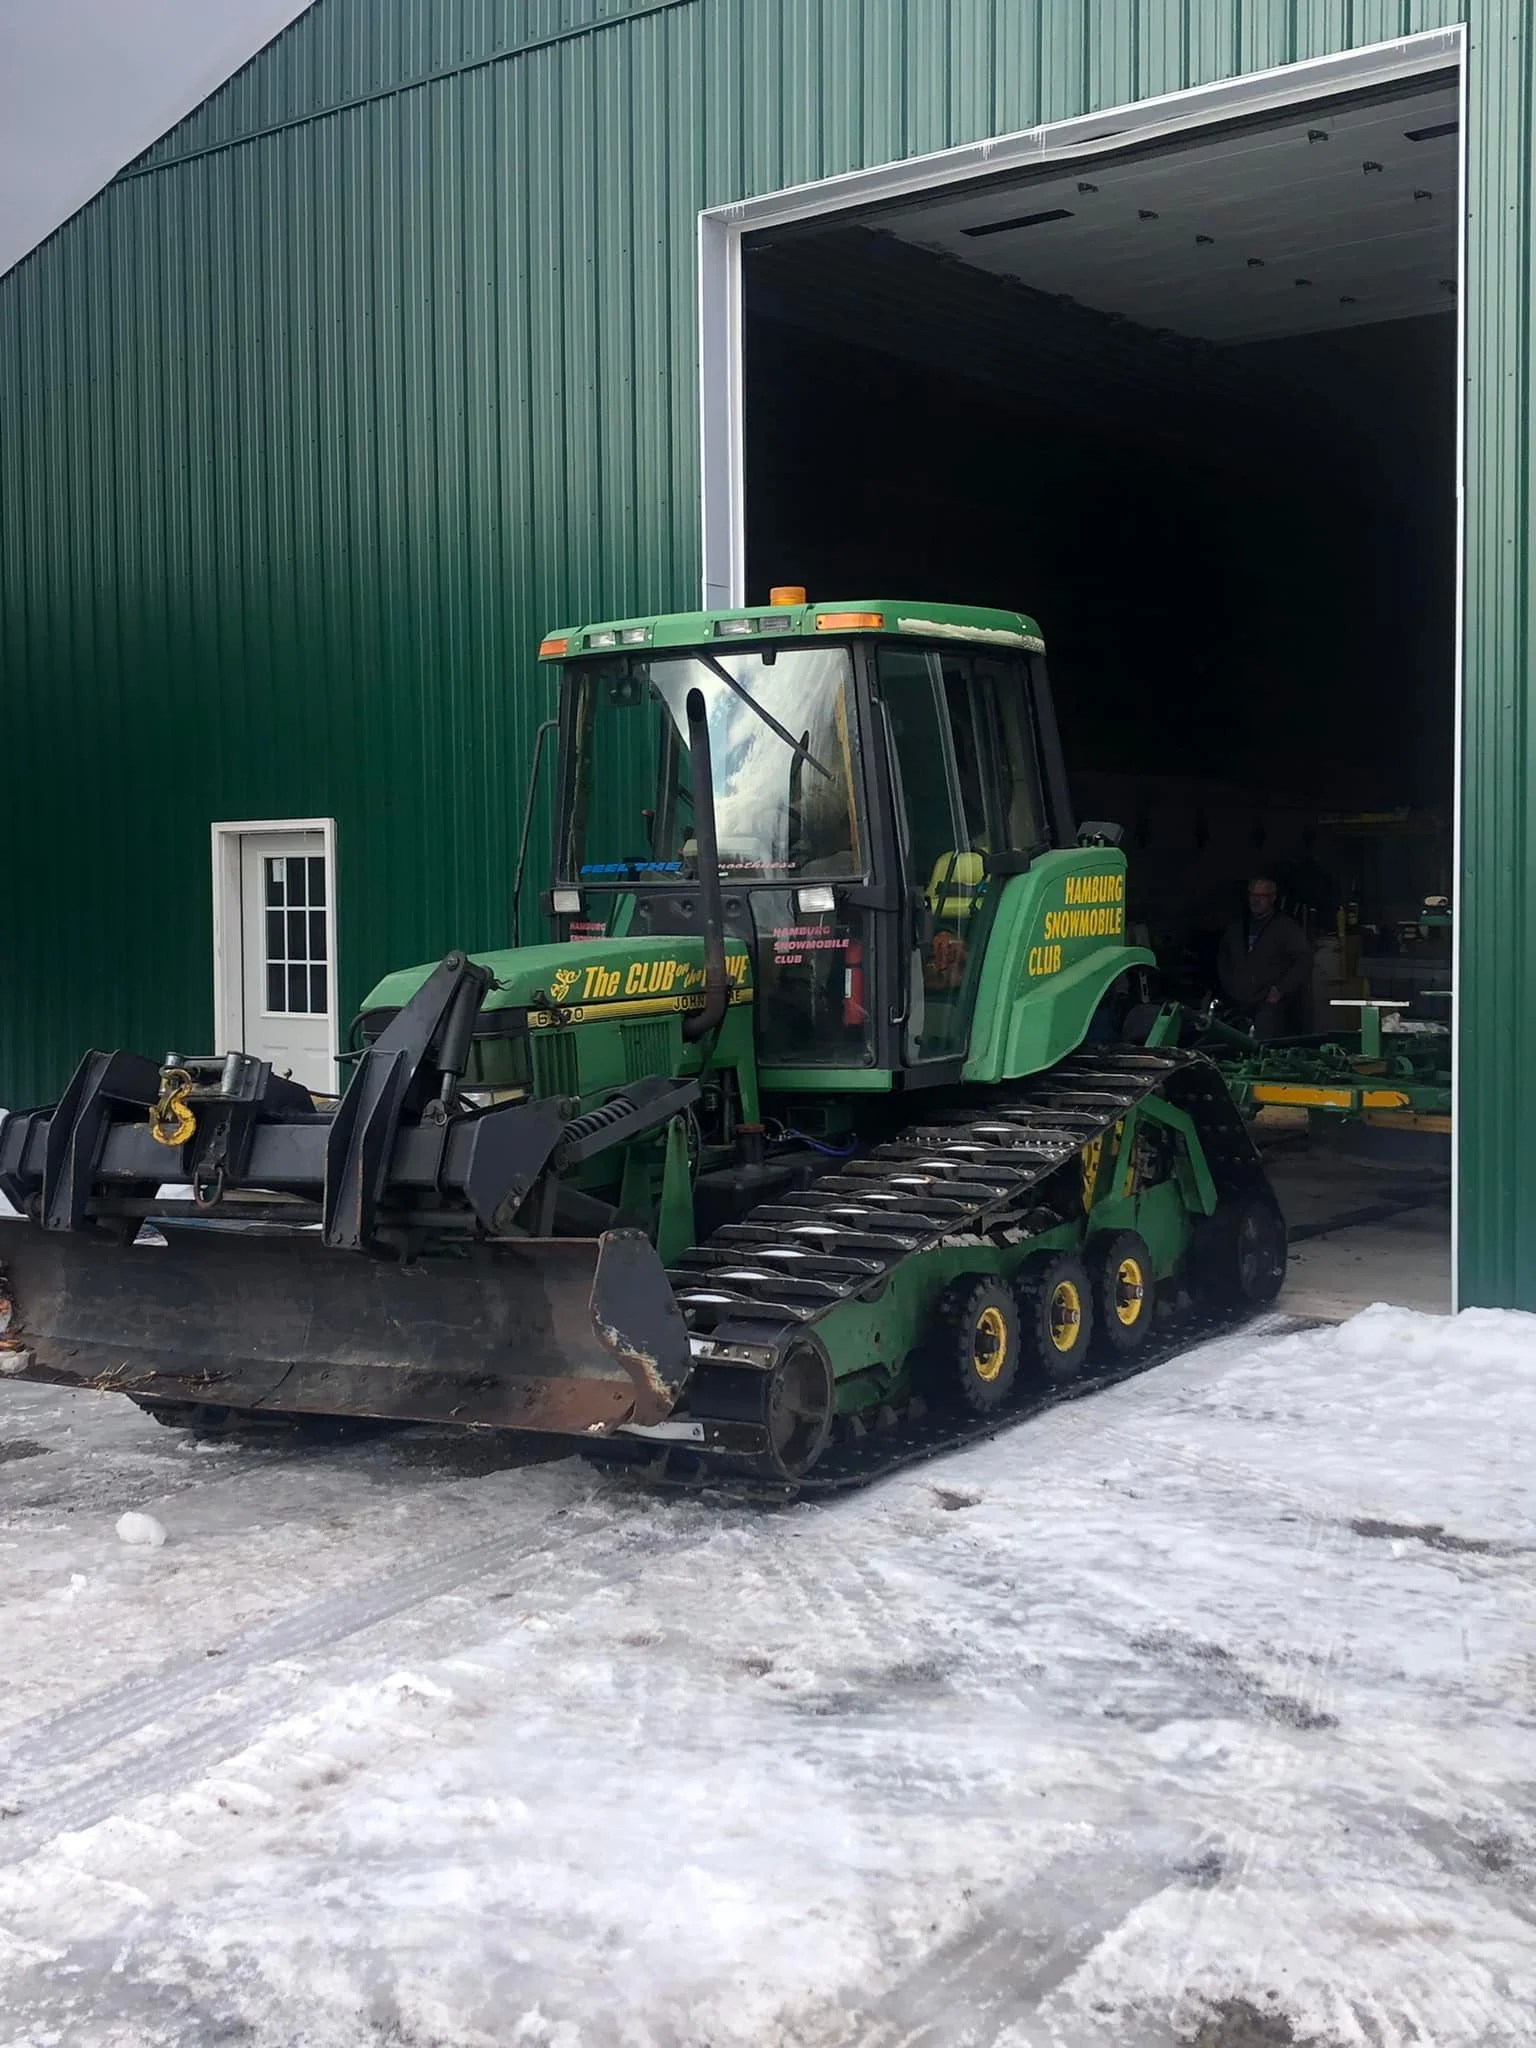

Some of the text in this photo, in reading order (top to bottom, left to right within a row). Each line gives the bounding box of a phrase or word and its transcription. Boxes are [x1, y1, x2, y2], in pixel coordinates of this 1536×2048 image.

[580, 860, 796, 874] FEEL THE oothness
[1065, 875, 1123, 905] HAMBURG
[773, 926, 831, 937] HAMBURG
[1044, 907, 1122, 940] SNOWMOBILE
[773, 939, 849, 951] SNOWMOBILE
[774, 955, 802, 965] CLUB
[1028, 945, 1061, 976] CLUB
[582, 966, 621, 999] The
[625, 960, 677, 995] CLUB
[673, 994, 706, 1012] JOHN
[536, 1007, 584, 1027] 60
